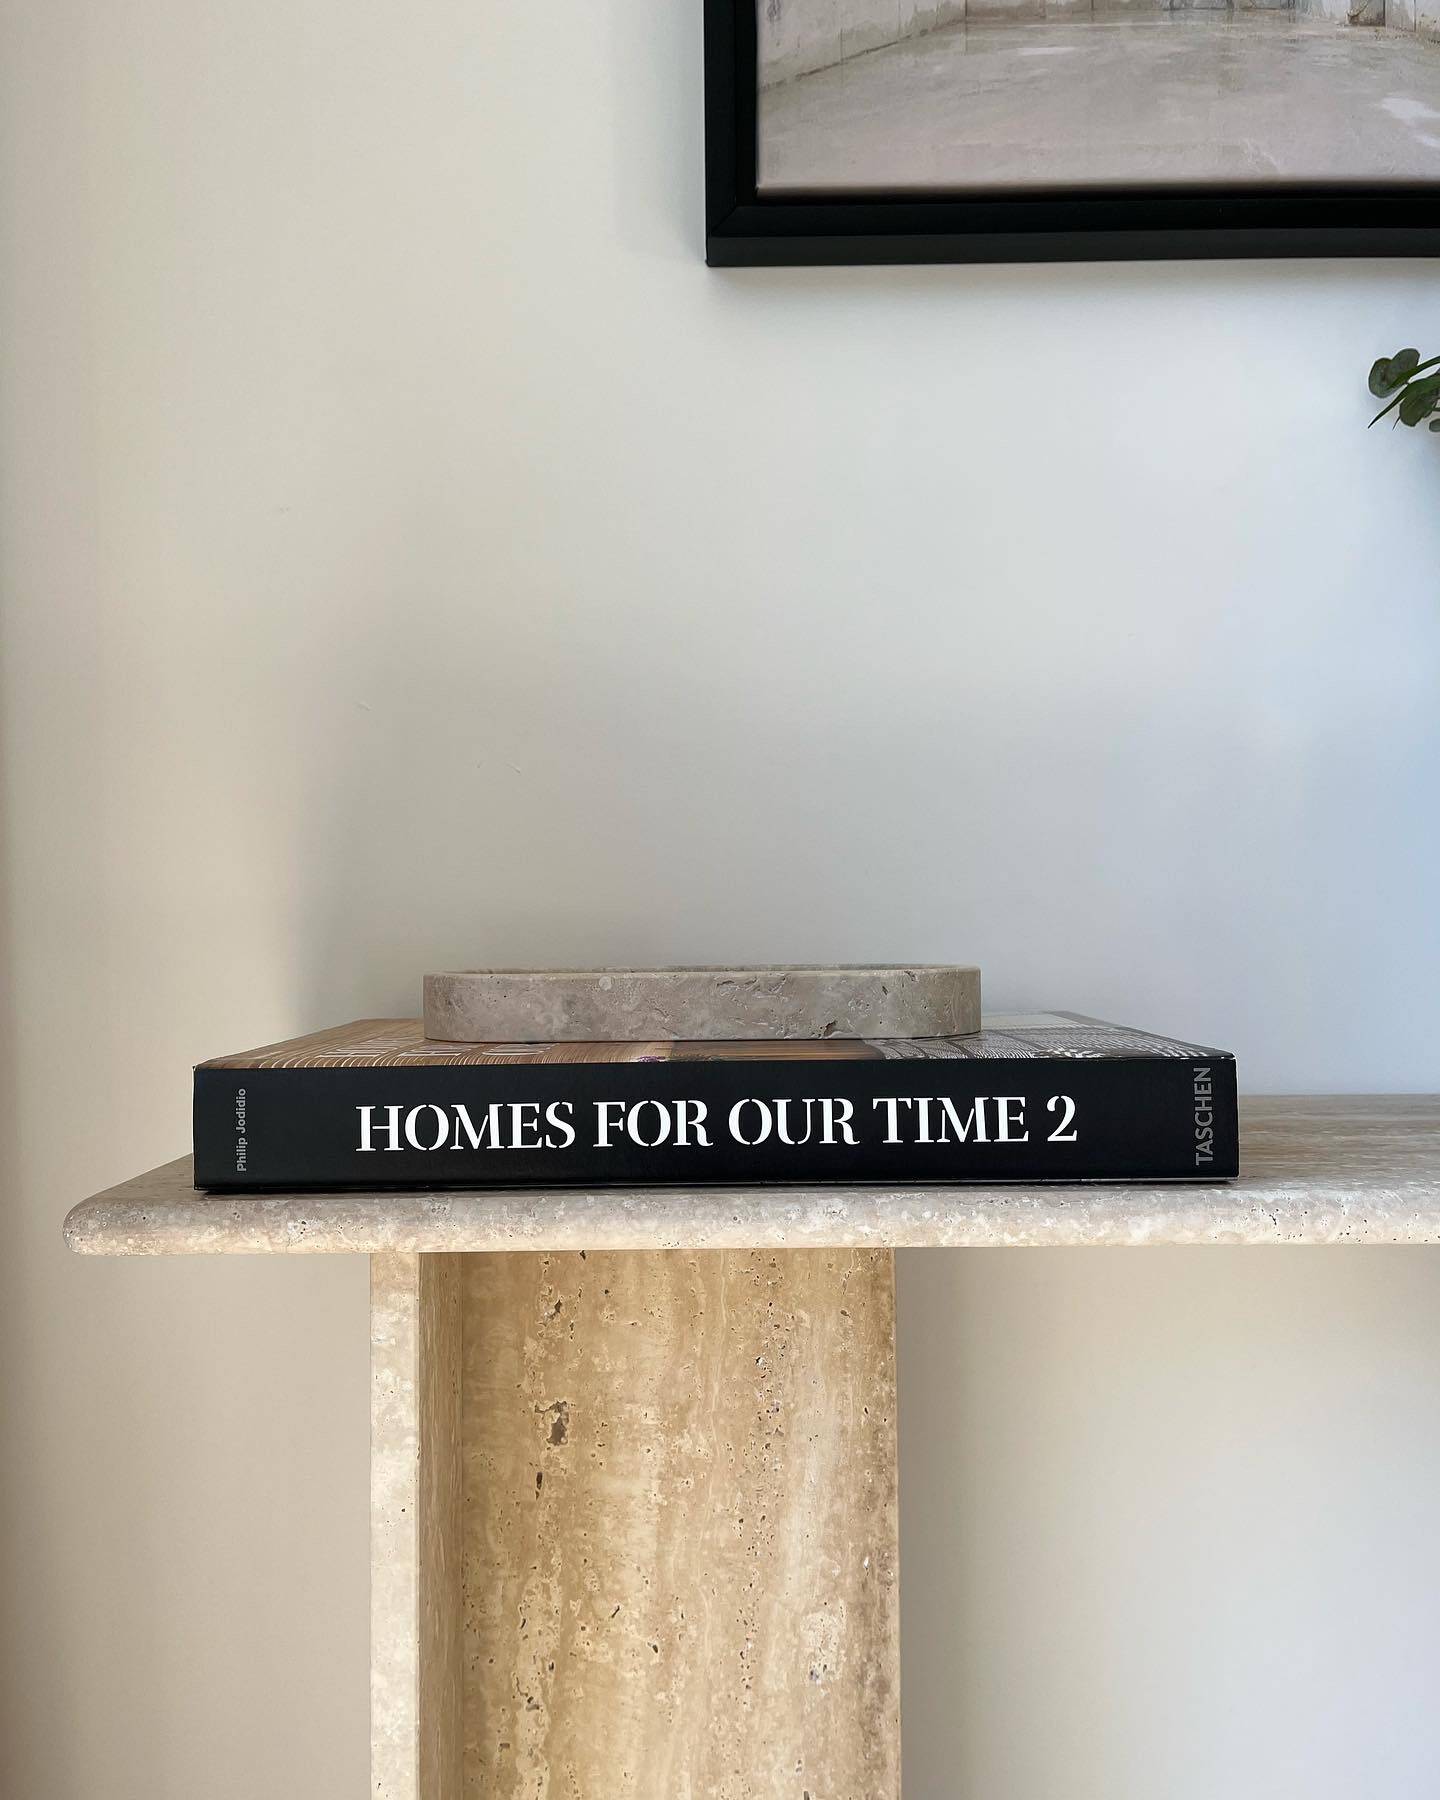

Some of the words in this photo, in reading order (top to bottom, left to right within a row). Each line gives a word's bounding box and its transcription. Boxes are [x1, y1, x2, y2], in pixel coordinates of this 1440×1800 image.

[236, 1088, 247, 1133] Jodidio
[356, 1102, 575, 1151] HOMES
[593, 1100, 713, 1147] FOR
[729, 1098, 860, 1145] OUR
[873, 1097, 1028, 1143] TIME
[1047, 1096, 1077, 1141] 2
[1194, 1067, 1213, 1166] TASCHEN
[236, 1137, 248, 1172] Philip
